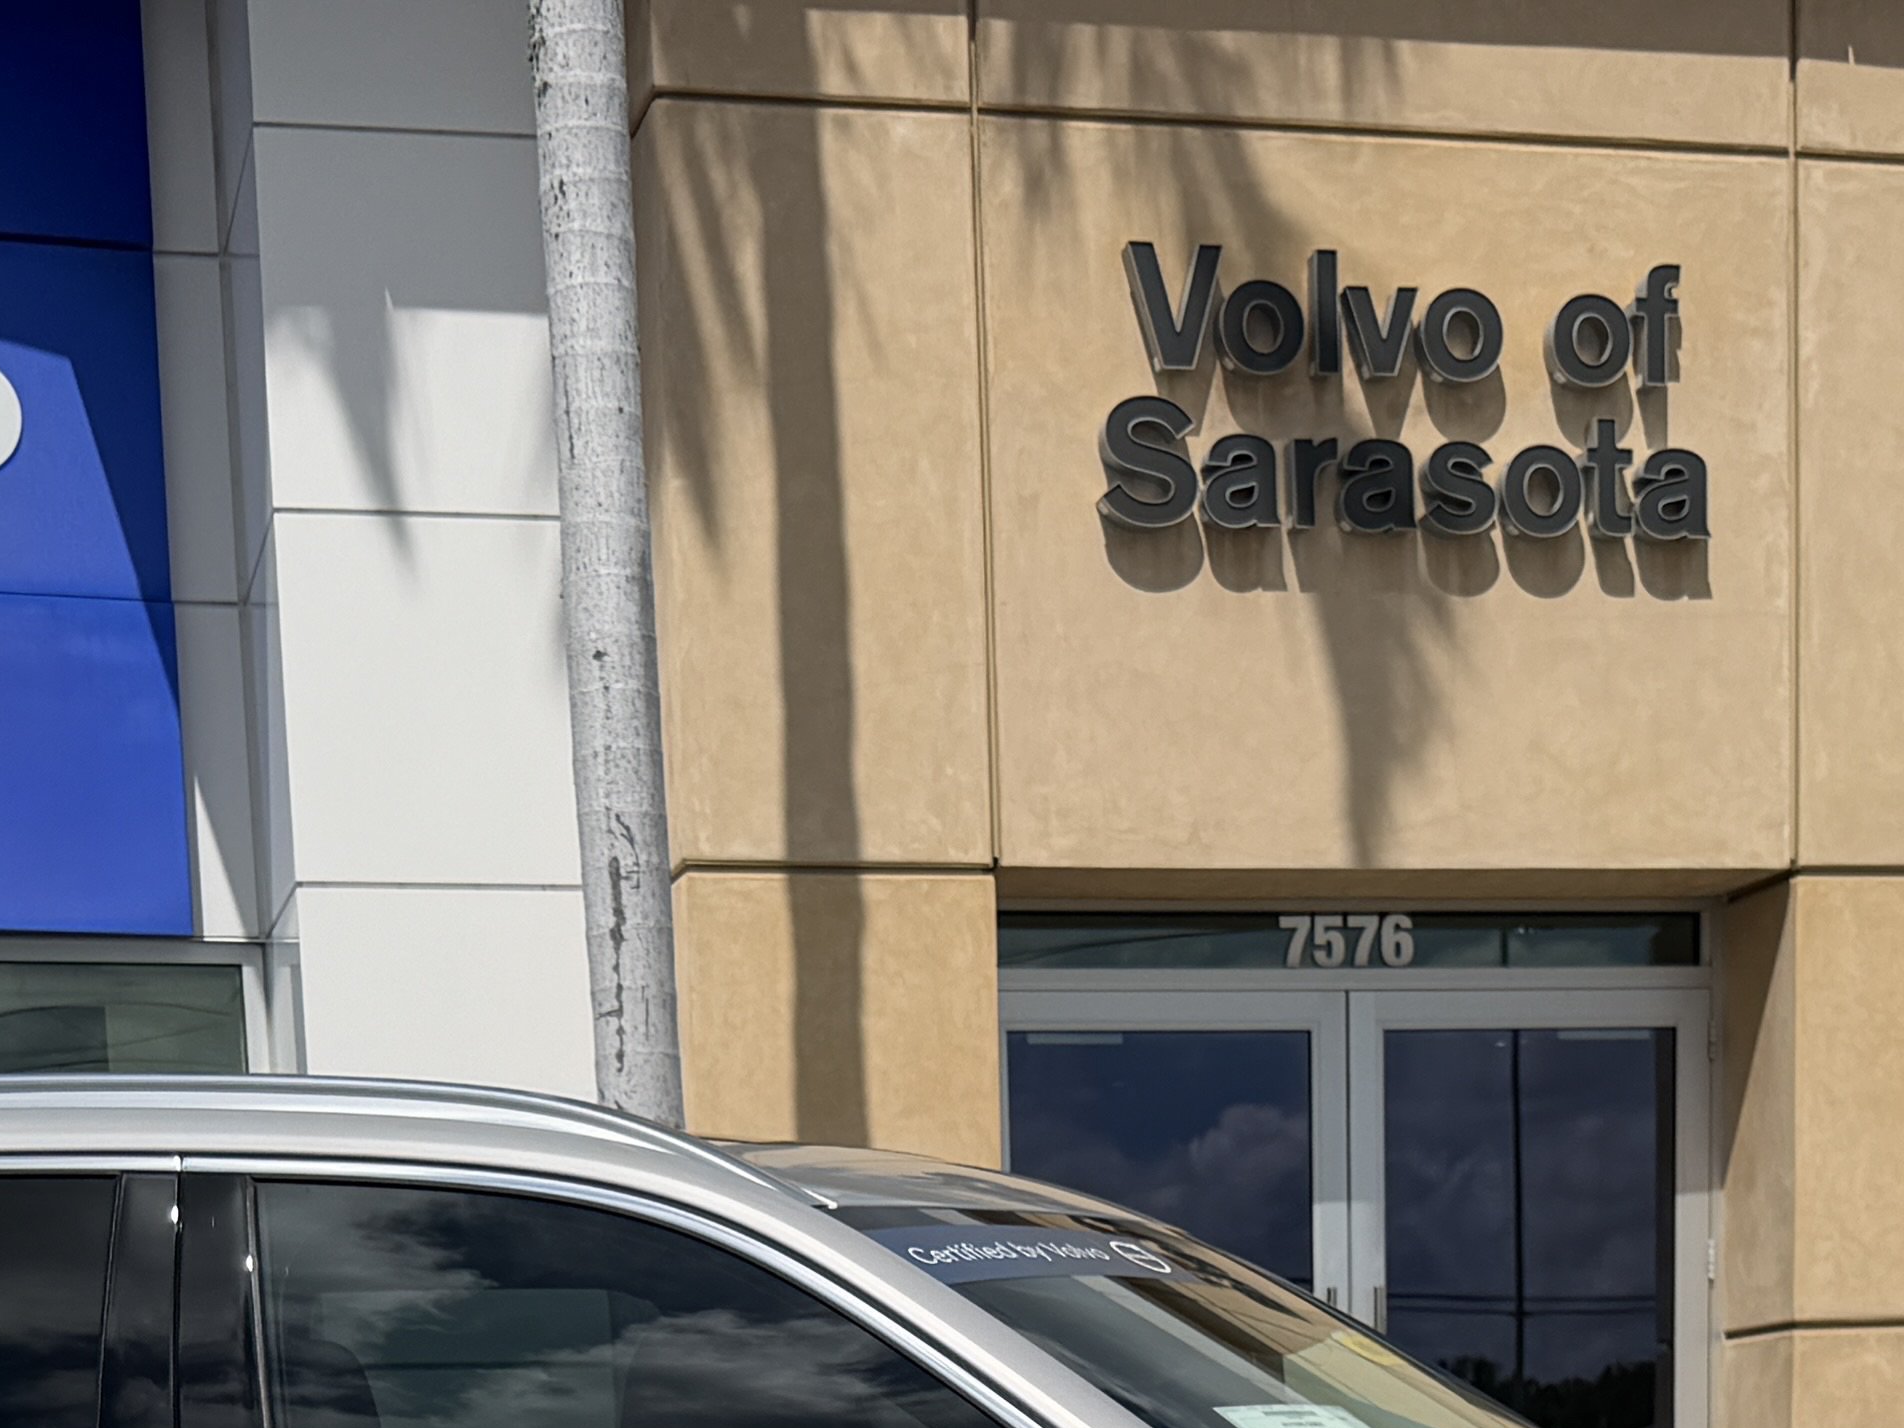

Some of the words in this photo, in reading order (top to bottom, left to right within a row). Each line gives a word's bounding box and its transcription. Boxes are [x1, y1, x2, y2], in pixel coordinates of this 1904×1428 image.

[1121, 241, 1503, 380] Volvo
[1543, 264, 1681, 387] of
[1097, 395, 1711, 539] Sarasota
[1278, 914, 1415, 968] 7576
[908, 1241, 1018, 1265] Certified
[1007, 1241, 1052, 1262] by
[1037, 1241, 1111, 1261] Volvo
